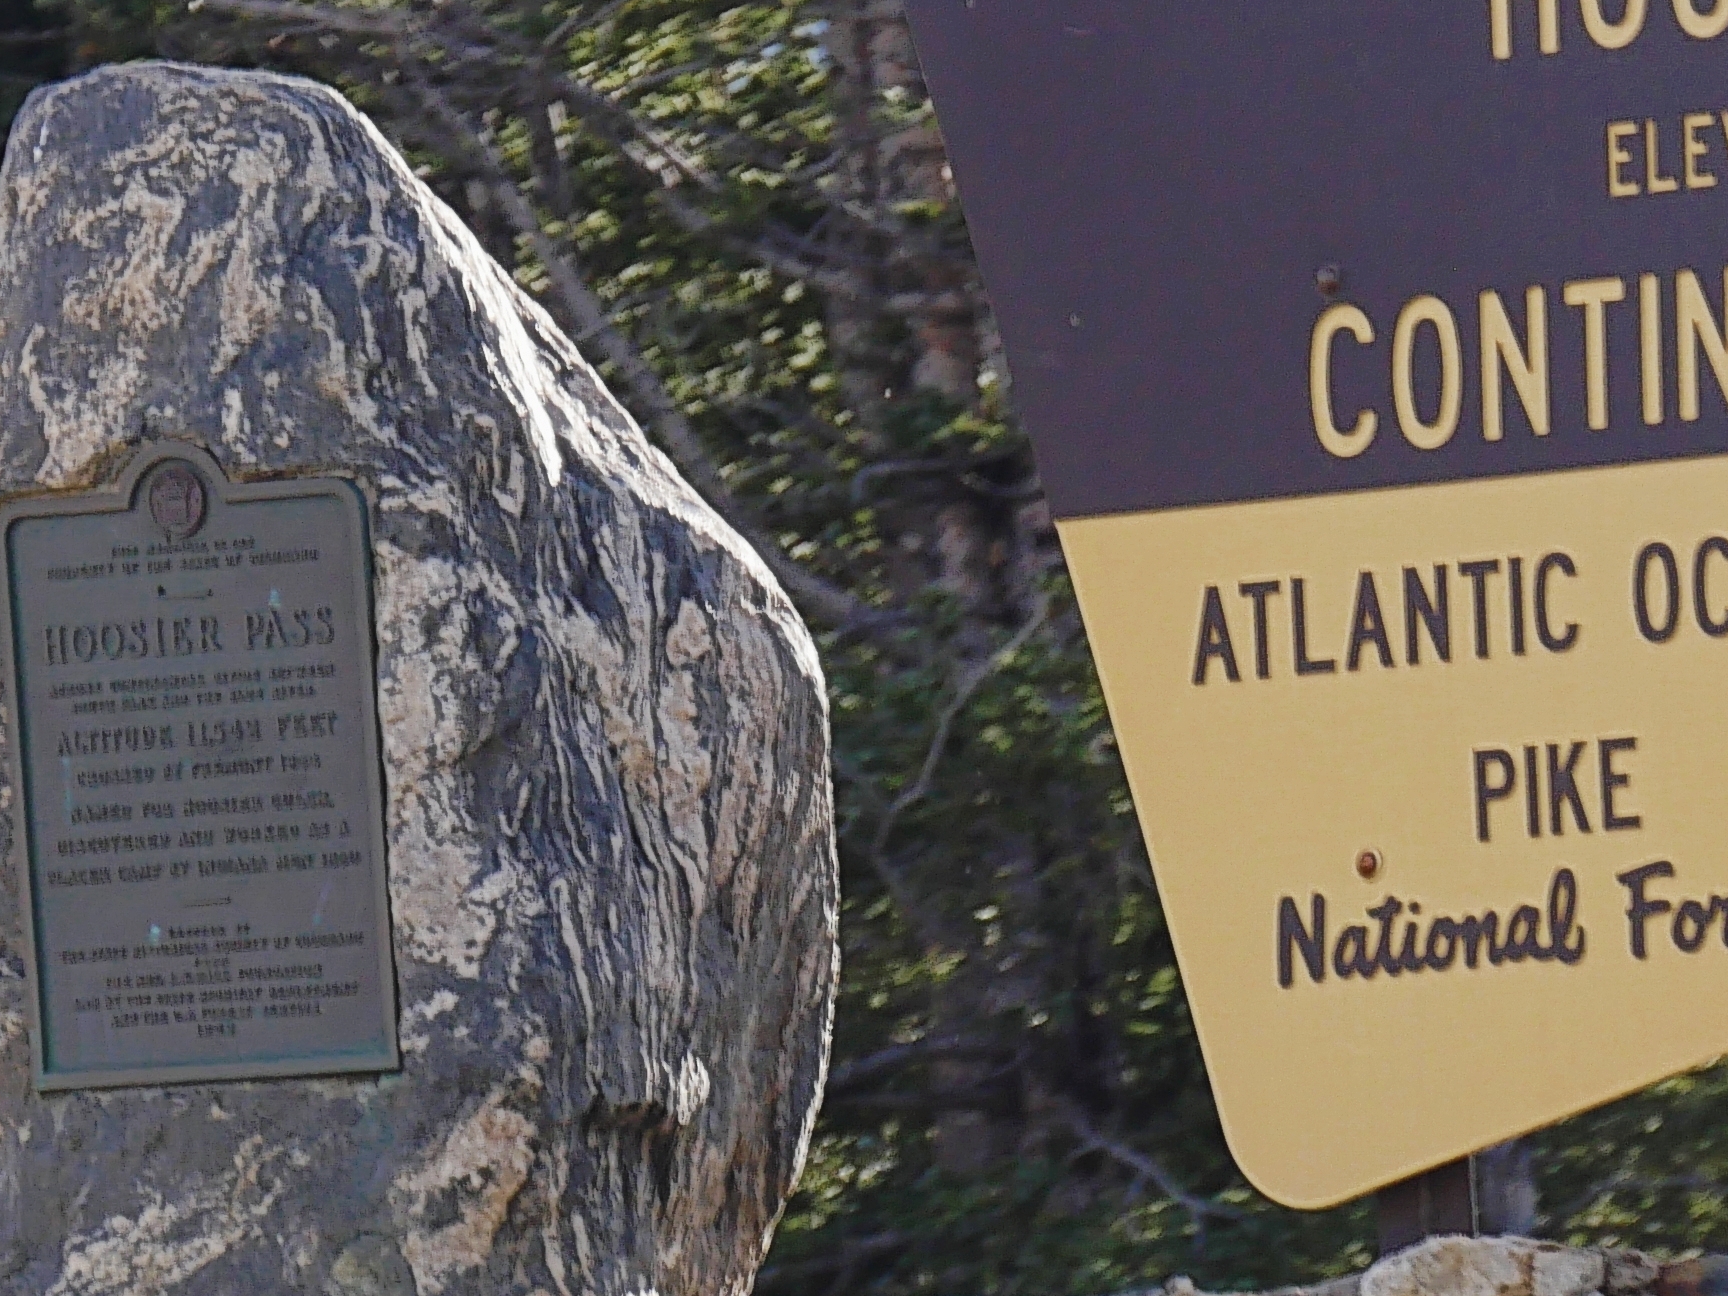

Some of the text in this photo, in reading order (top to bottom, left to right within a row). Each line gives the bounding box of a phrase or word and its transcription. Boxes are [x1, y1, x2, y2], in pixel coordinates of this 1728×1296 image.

[45, 605, 336, 667] HOOSIER PASS
[1194, 553, 1577, 683] ATLANTIC
[57, 725, 173, 757] ALTITUDE
[277, 710, 337, 740] FEET
[1475, 739, 1639, 840] PIKE
[1277, 874, 1584, 989] National
